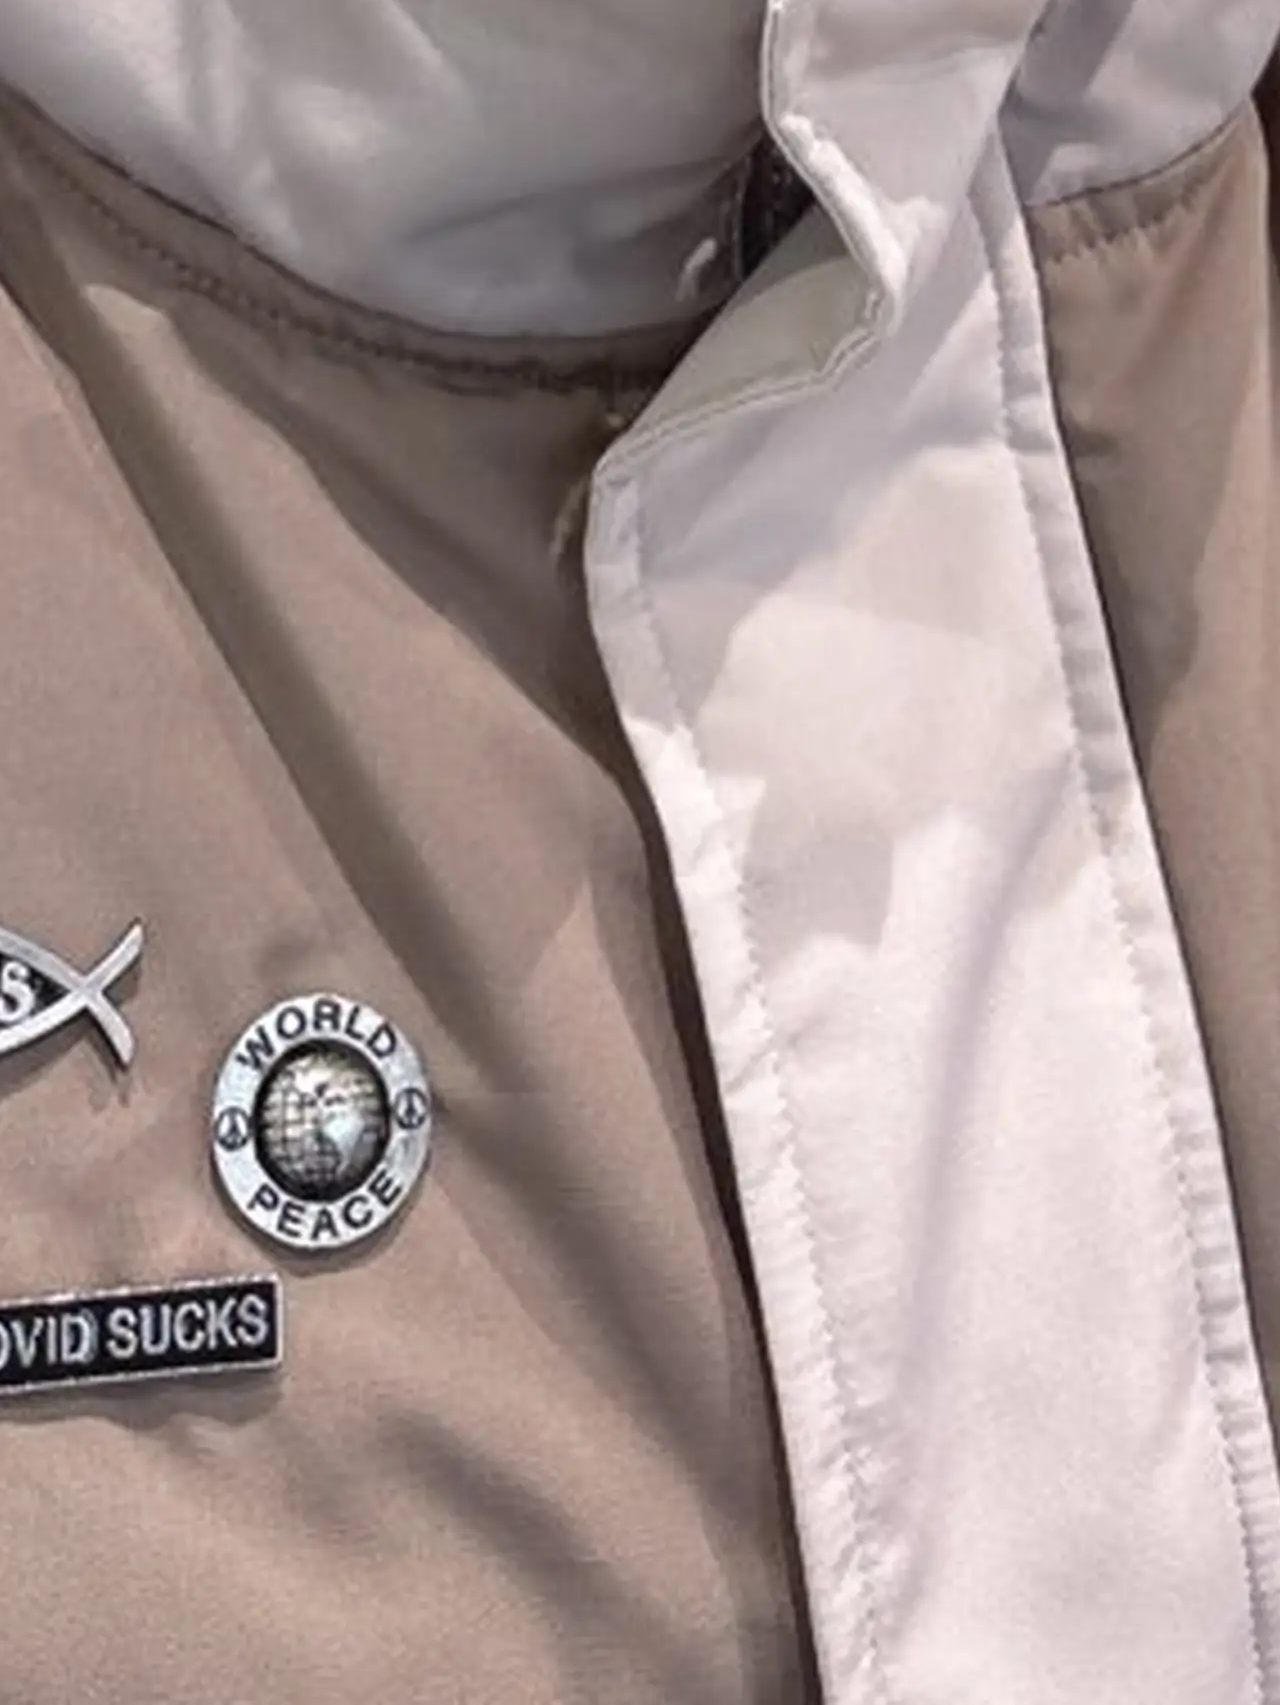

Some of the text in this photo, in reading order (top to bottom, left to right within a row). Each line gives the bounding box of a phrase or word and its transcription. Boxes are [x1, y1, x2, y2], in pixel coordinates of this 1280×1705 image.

[235, 999, 397, 1070] WORLD
[247, 1167, 402, 1239] PEACE
[107, 1294, 268, 1359] SUCKS
